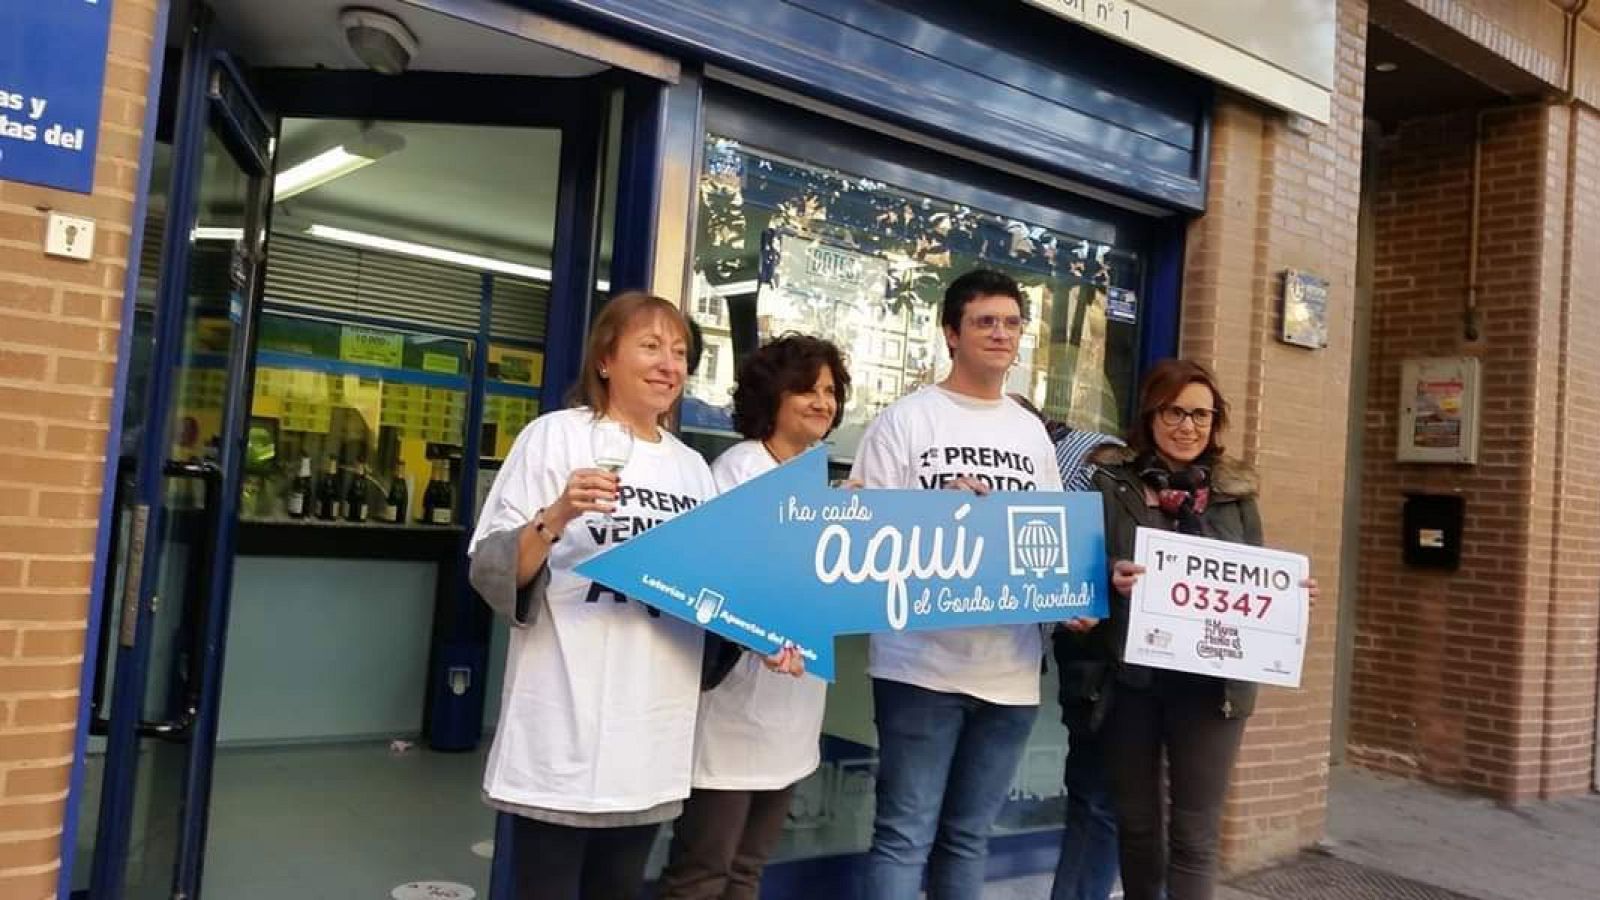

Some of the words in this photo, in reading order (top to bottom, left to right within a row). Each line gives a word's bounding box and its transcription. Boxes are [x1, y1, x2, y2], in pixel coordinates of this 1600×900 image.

[1123, 9, 1130, 30] 1
[29, 97, 47, 120] y
[44, 123, 84, 150] del
[944, 447, 1034, 475] PREMIO
[919, 474, 1037, 491] VEDIDO
[585, 516, 664, 546] VEN
[815, 503, 984, 631] aquí
[1156, 550, 1178, 571] 1er
[1186, 555, 1291, 591] PREMIO
[914, 588, 932, 615] el
[937, 585, 995, 612] Gordo
[999, 585, 1019, 610] de
[1171, 582, 1272, 619] 03347
